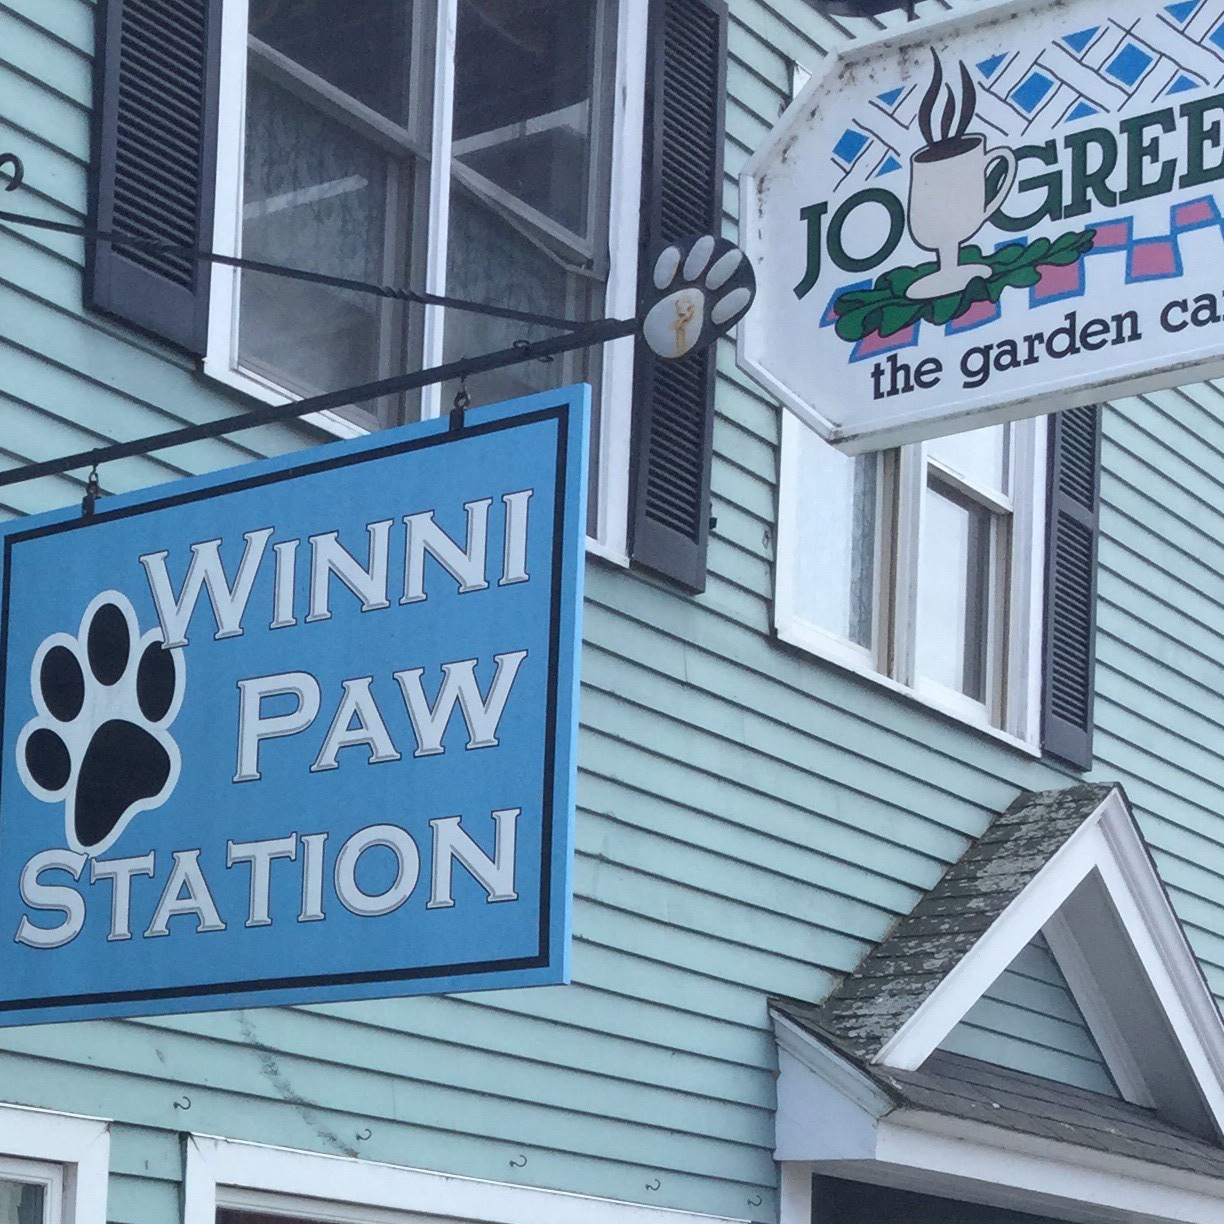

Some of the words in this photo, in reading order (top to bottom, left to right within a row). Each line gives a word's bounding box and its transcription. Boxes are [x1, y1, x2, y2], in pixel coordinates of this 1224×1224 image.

[793, 187, 905, 300] JO
[870, 352, 943, 400] the
[960, 309, 1142, 389] garden
[1160, 289, 1224, 333] ca
[139, 488, 535, 650] WINNI
[232, 649, 529, 784] PAW
[15, 807, 522, 950] STATION
